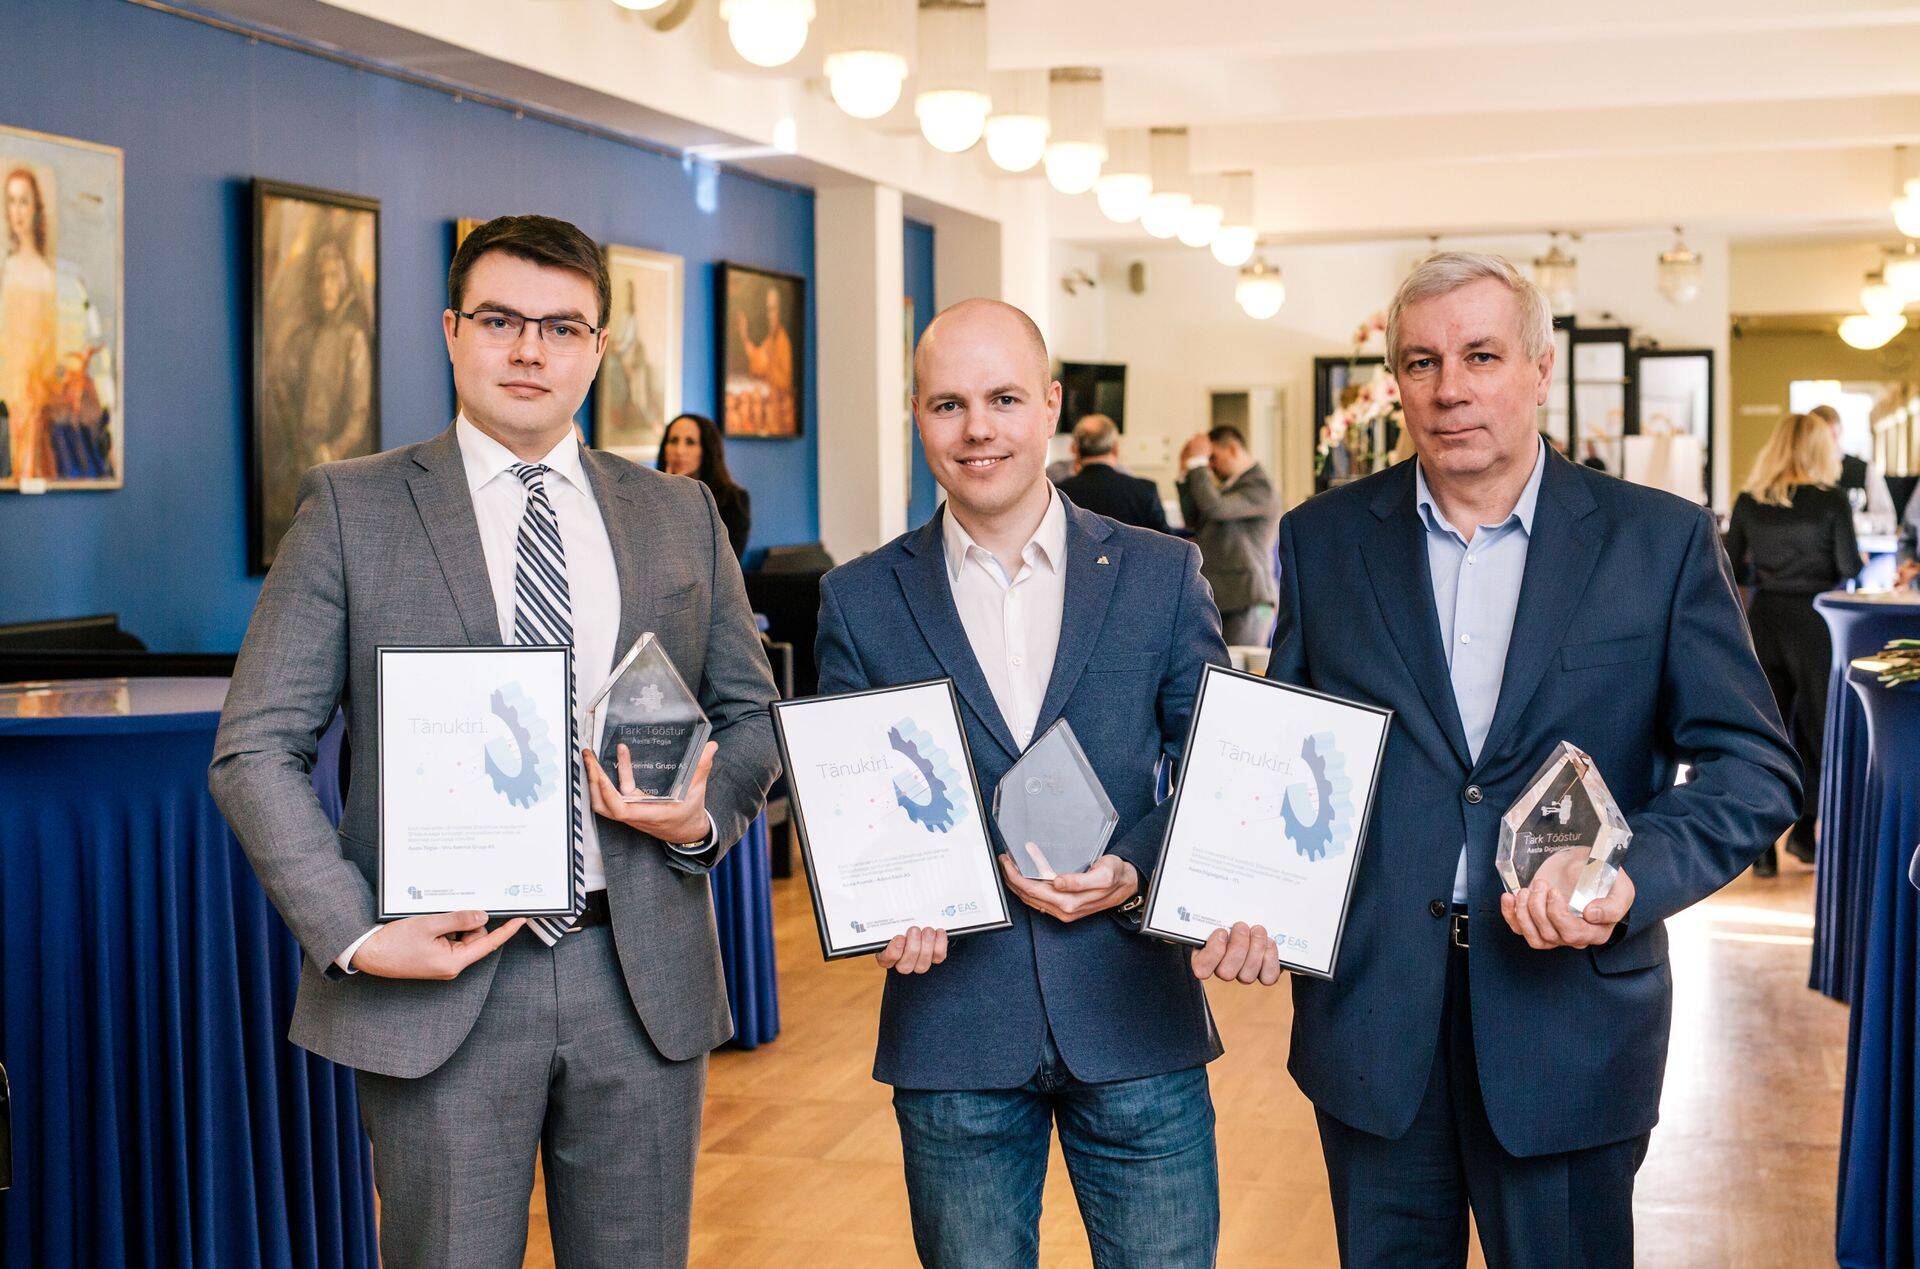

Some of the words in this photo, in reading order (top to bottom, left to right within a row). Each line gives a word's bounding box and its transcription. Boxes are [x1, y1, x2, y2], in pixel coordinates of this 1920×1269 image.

[619, 725, 641, 736] Tark
[645, 725, 686, 736] Tööstur
[1219, 739, 1293, 776] Tänukiri.
[655, 762, 677, 770] Grupp
[816, 755, 894, 779] Tänukiri.
[1524, 834, 1544, 844] Tark
[1547, 832, 1583, 843] Tööstur
[522, 884, 544, 894] EAS
[958, 902, 978, 913] EAS
[1288, 937, 1309, 950] EAS
